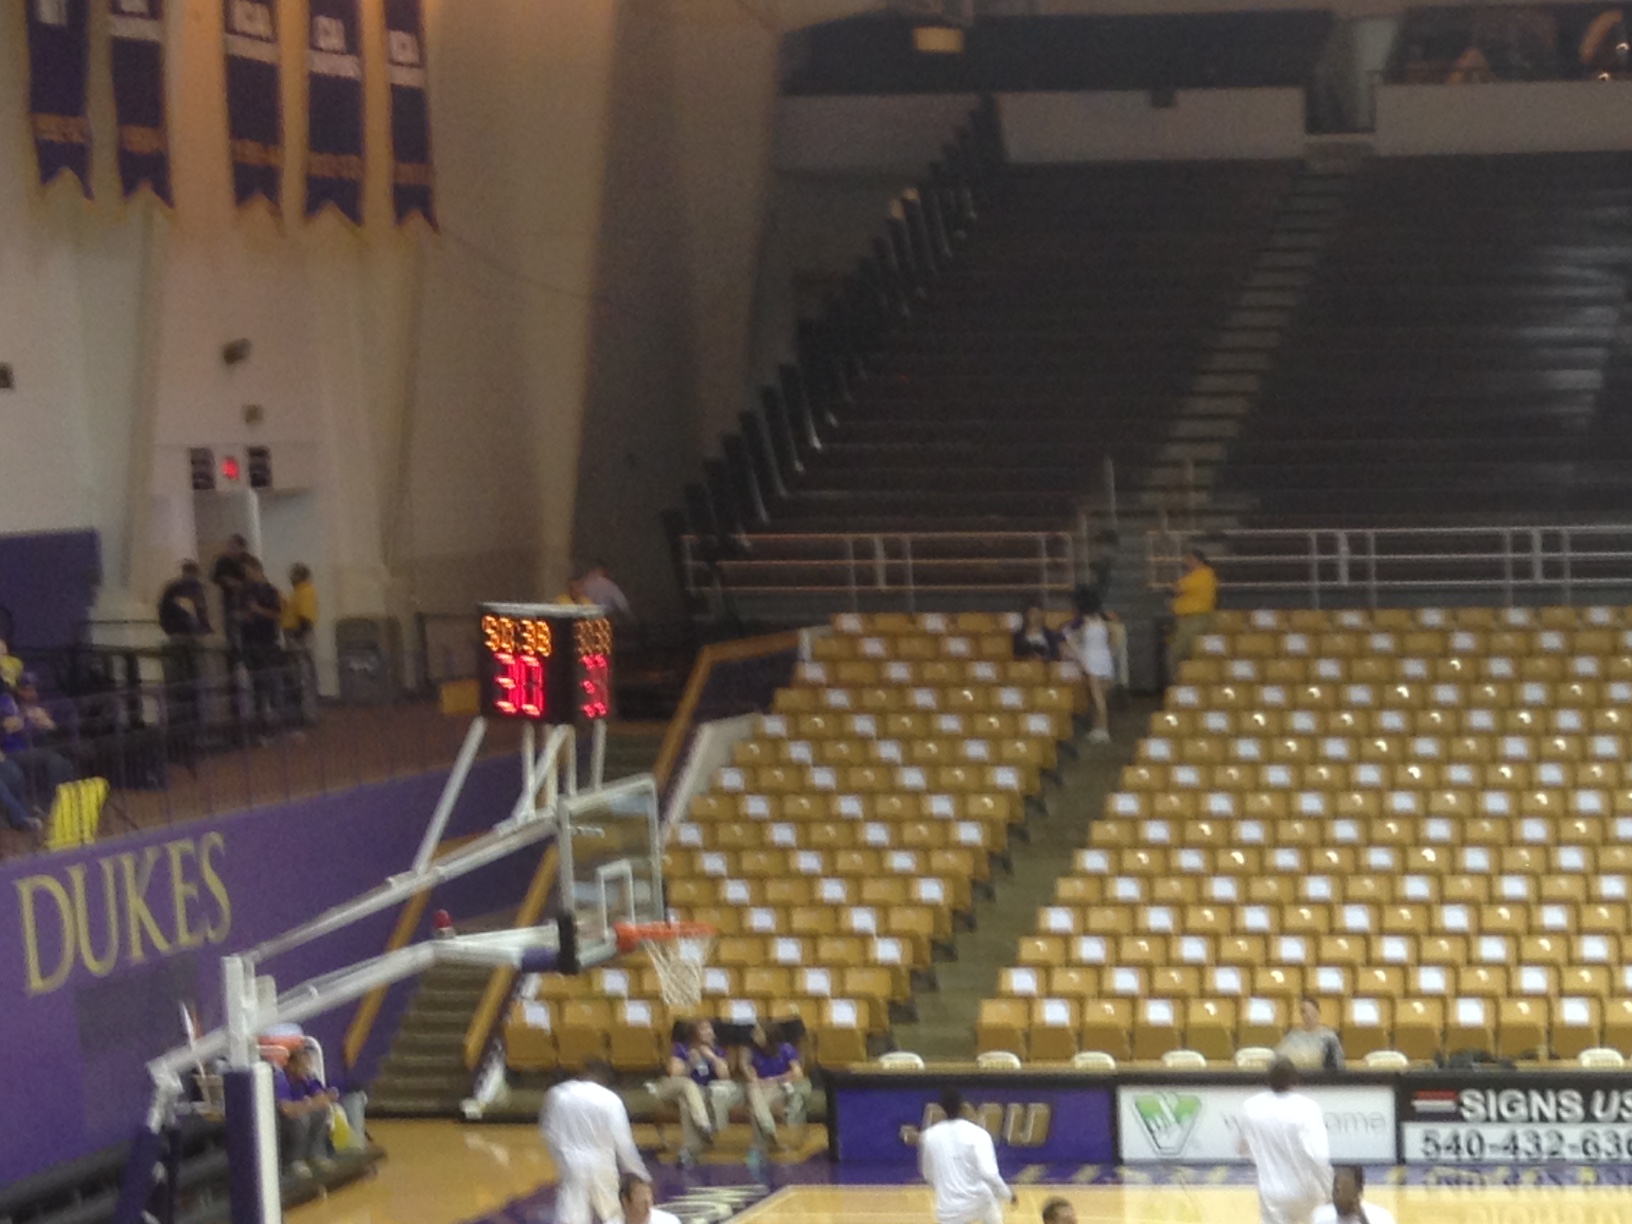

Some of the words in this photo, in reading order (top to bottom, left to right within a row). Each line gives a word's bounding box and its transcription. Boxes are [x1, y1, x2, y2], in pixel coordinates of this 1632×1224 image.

[495, 653, 544, 716] 30
[12, 831, 231, 996] DUKES
[1459, 1088, 1585, 1124] SIGNS
